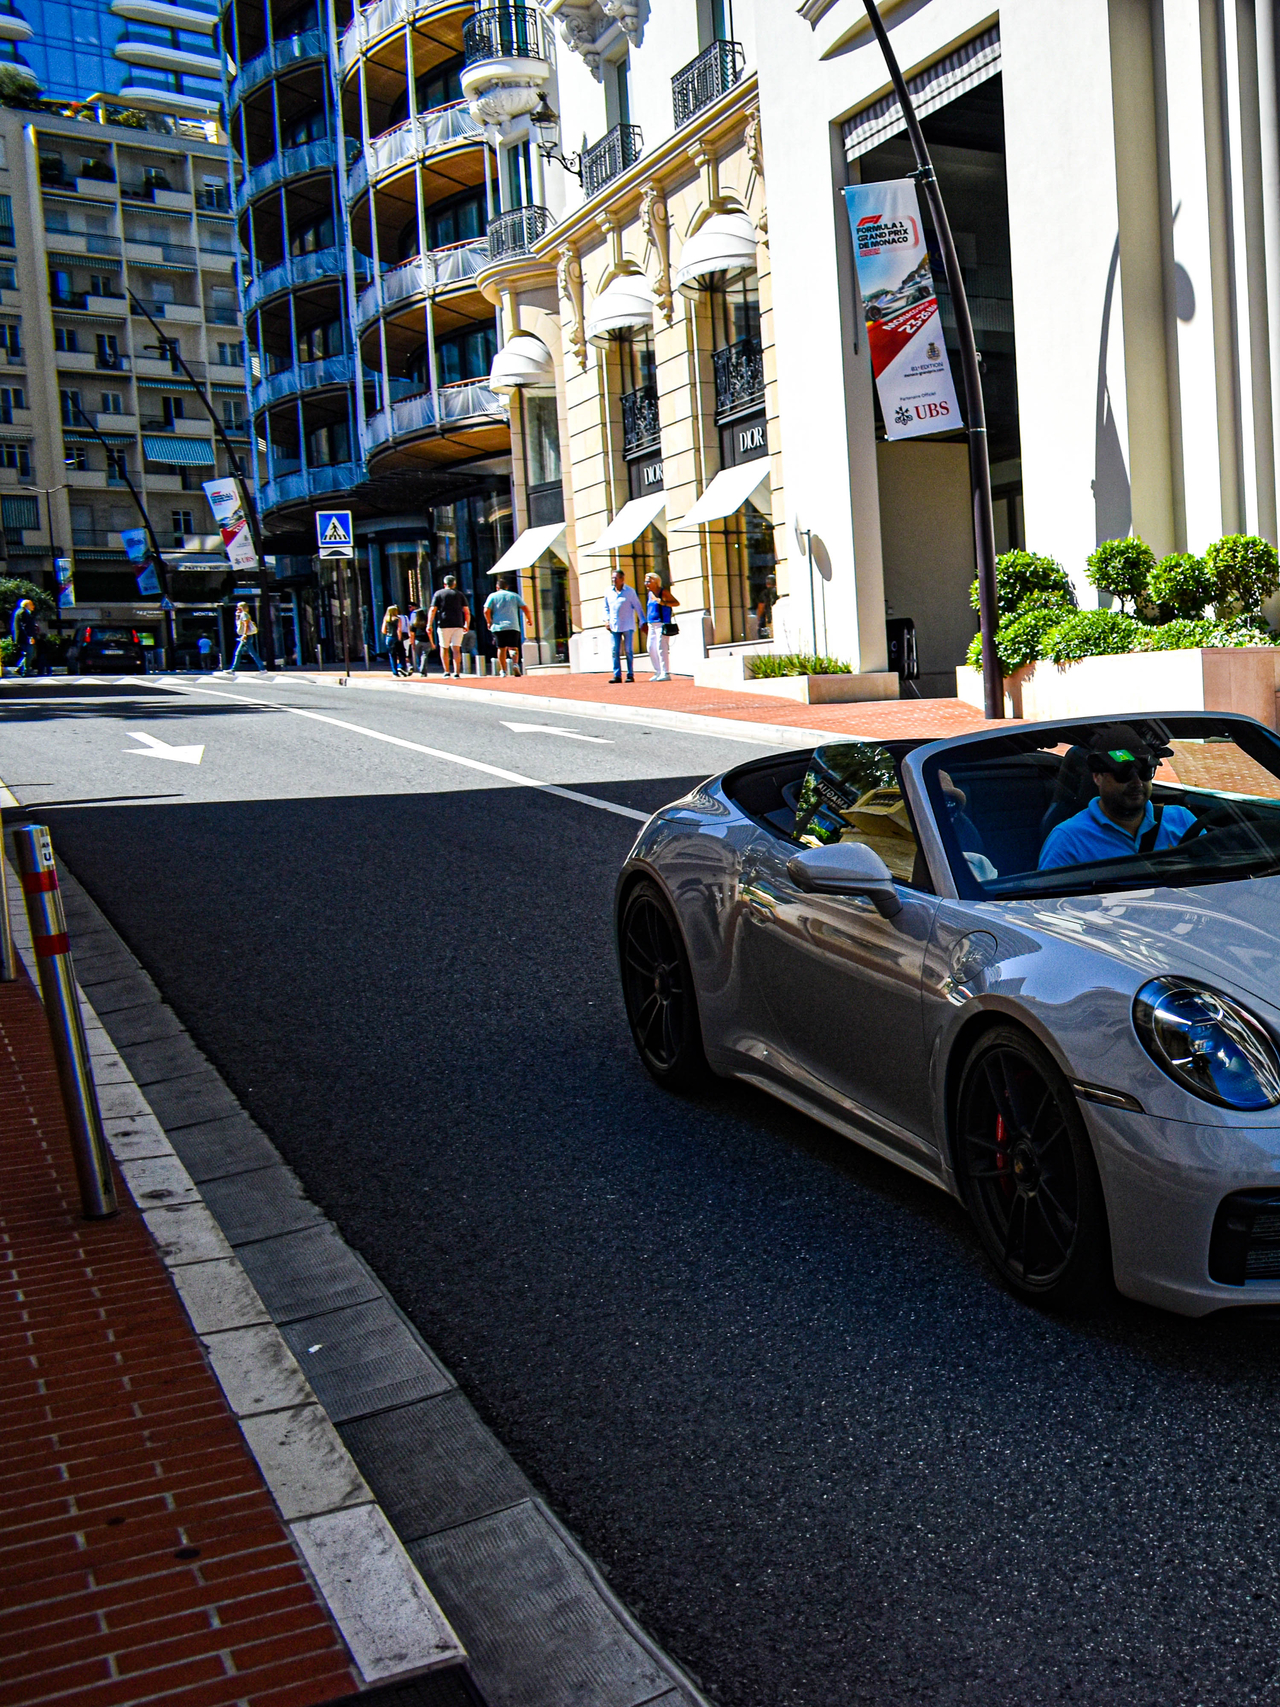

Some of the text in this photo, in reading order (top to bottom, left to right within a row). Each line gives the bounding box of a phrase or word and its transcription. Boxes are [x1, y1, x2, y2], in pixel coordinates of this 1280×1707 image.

[856, 222, 897, 235] FORMULA
[857, 228, 909, 242] GRAND PRIX
[858, 236, 909, 250] DE MONACO
[897, 311, 931, 334] 23-26
[914, 400, 950, 420] UBS
[740, 426, 764, 453] DIOR
[643, 463, 664, 486] DIOR
